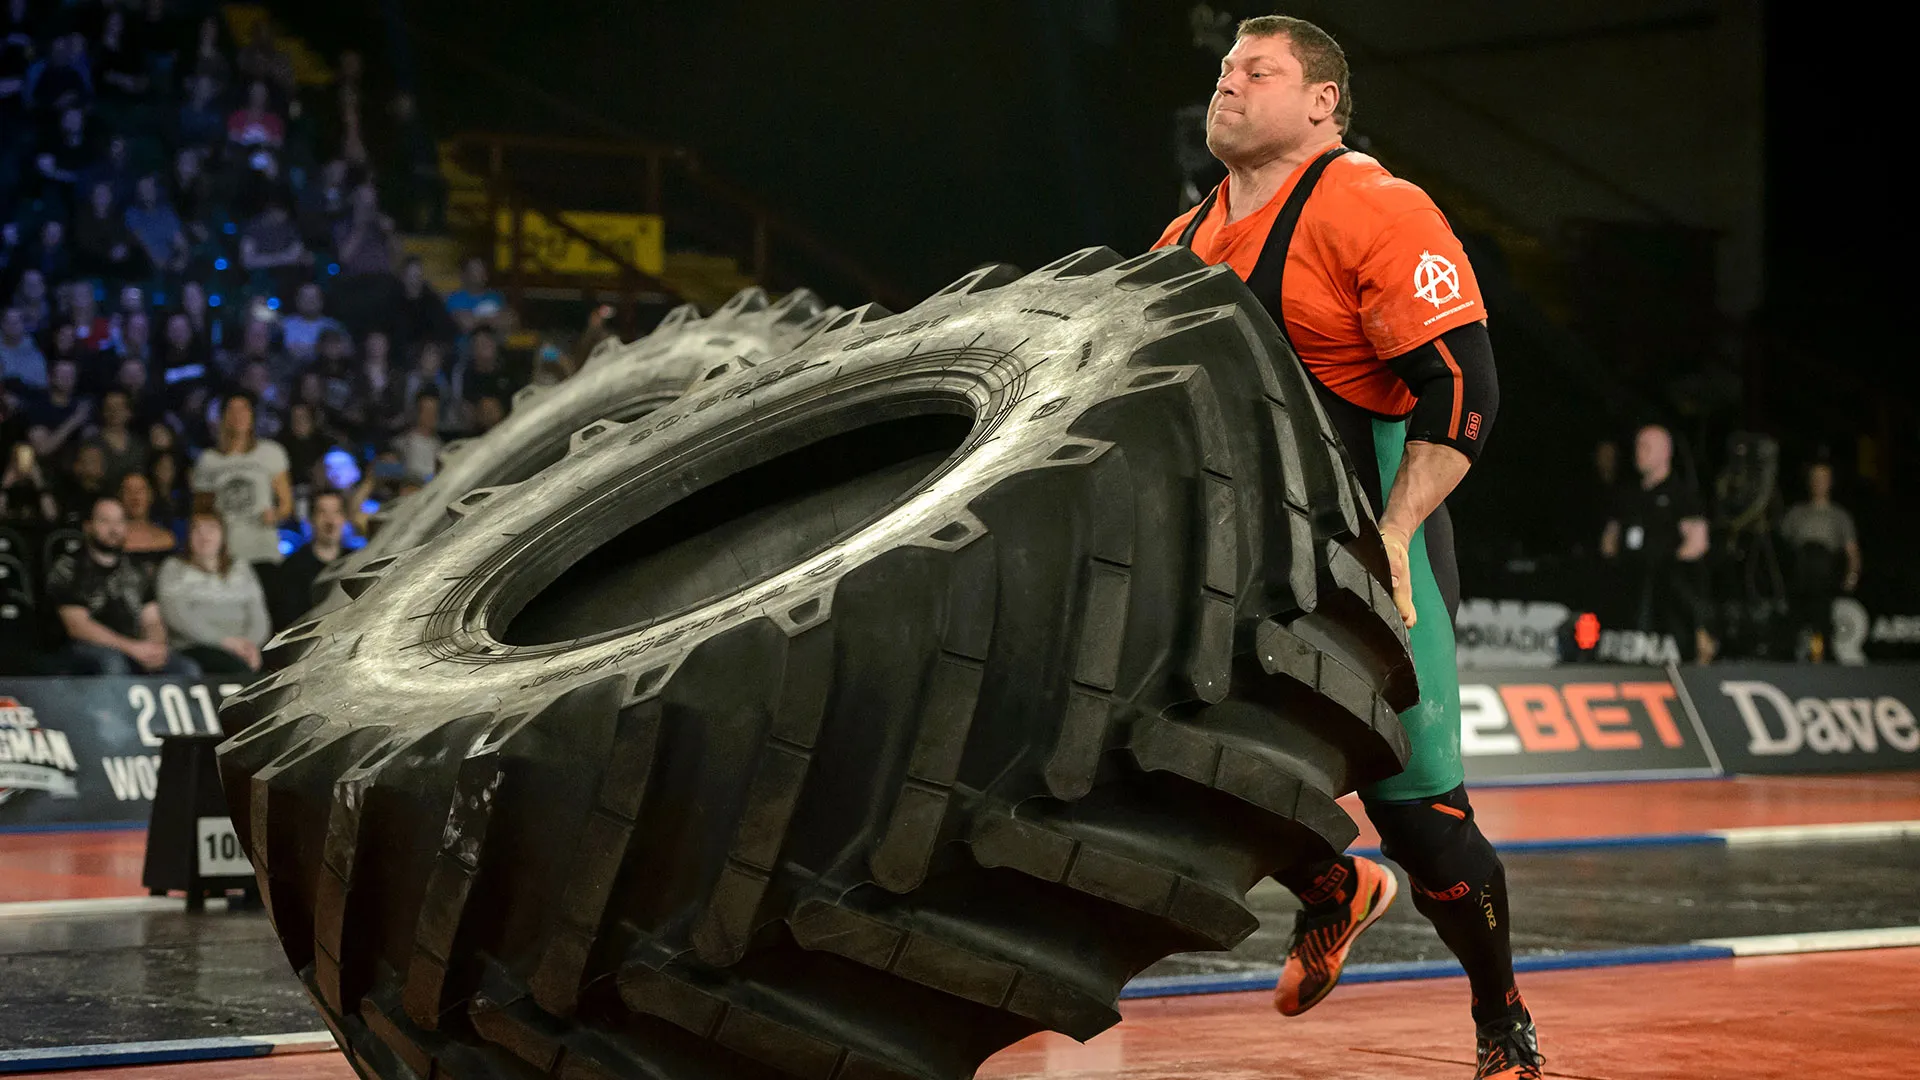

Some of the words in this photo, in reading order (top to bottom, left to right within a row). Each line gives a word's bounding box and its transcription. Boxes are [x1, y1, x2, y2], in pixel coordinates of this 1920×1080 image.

[1466, 412, 1482, 440] SBD
[1721, 680, 1920, 755] Dave
[102, 755, 161, 801] WO
[205, 833, 244, 860] 10
